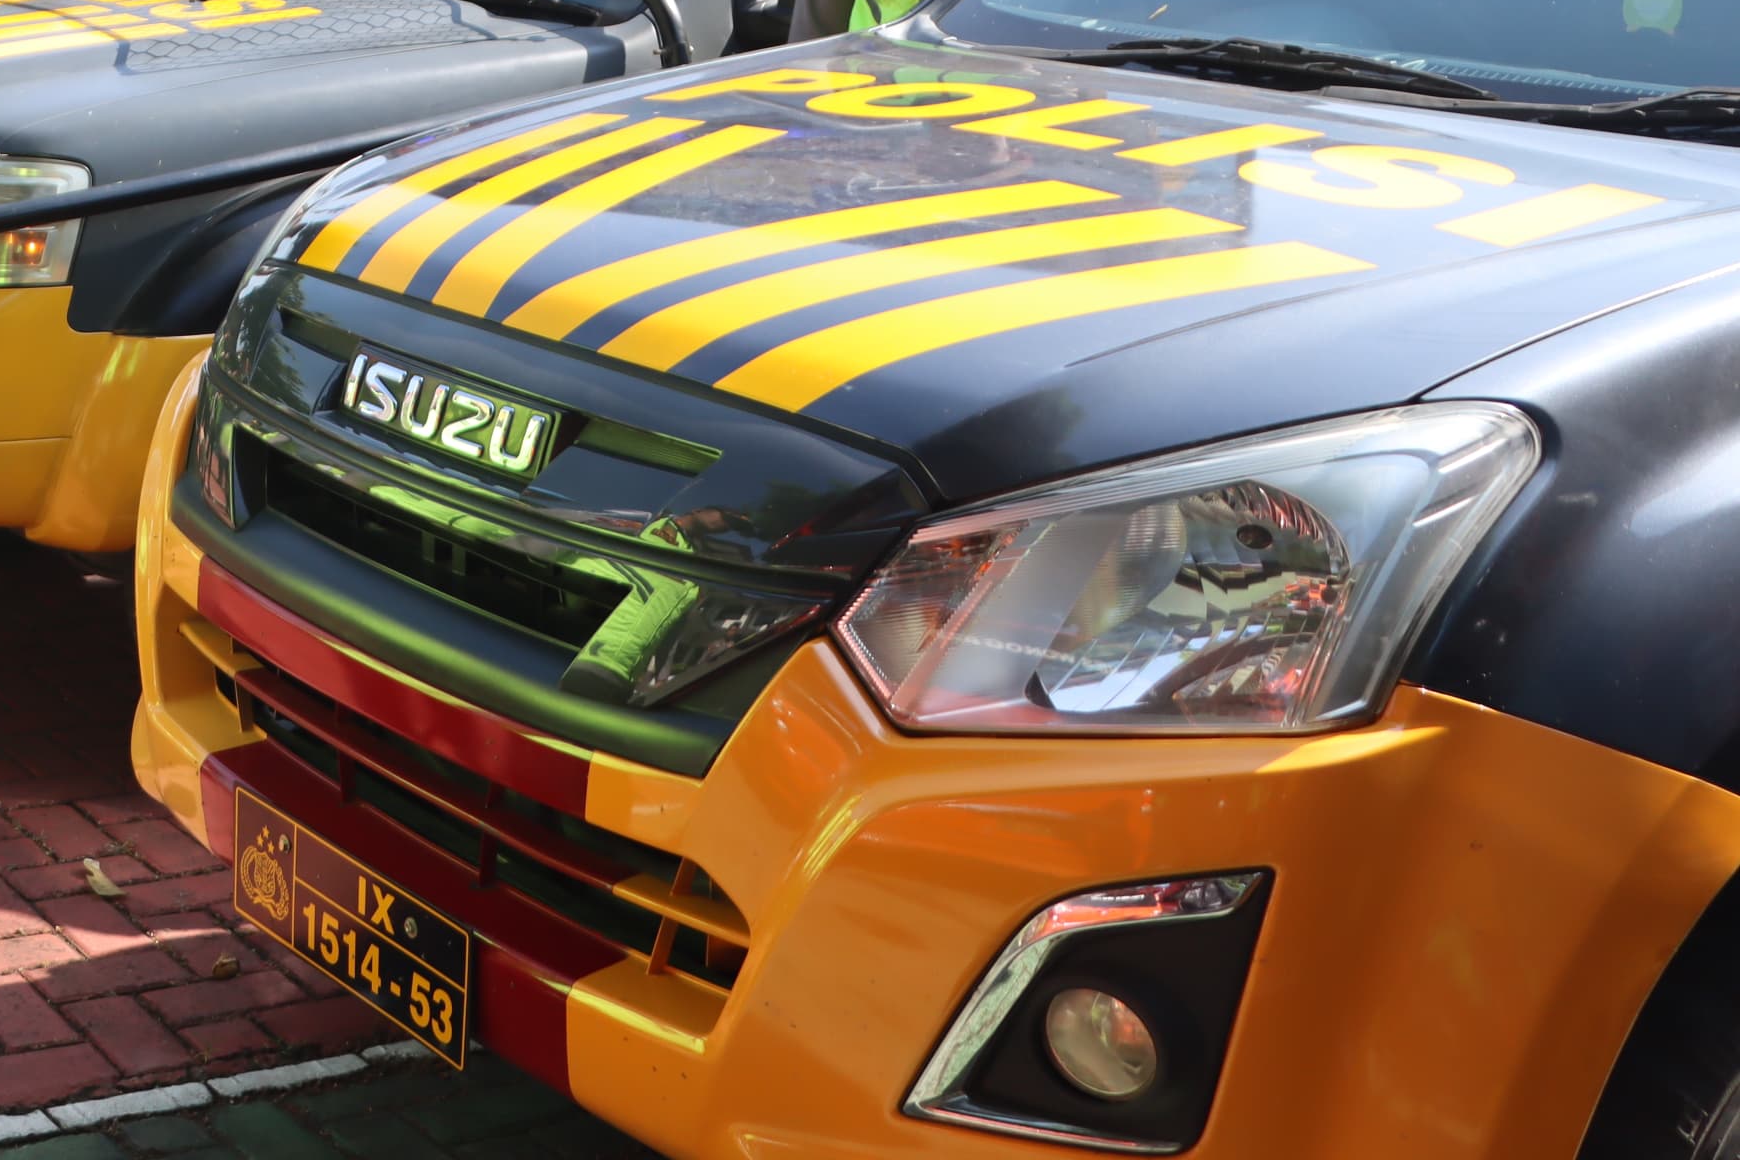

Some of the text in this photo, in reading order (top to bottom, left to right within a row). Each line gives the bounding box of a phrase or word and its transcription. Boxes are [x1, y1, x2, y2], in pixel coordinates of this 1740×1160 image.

[644, 67, 1666, 248] POLISI
[344, 352, 547, 473] ISUZU
[357, 875, 396, 936] IX
